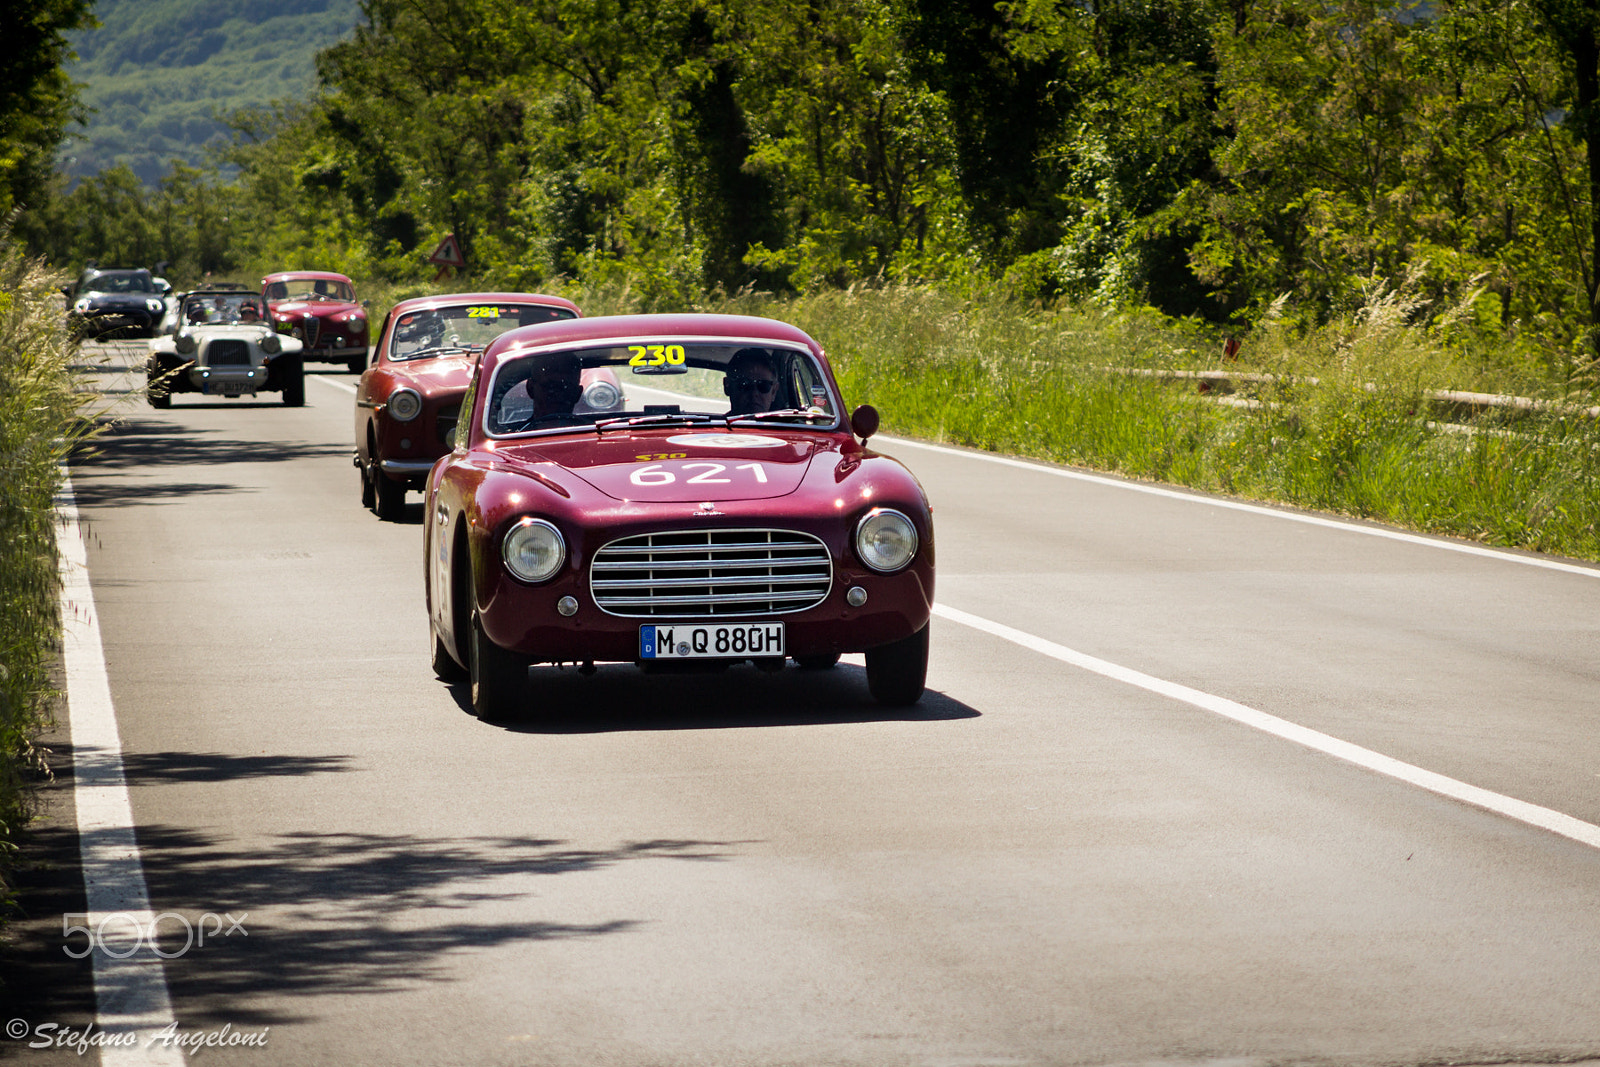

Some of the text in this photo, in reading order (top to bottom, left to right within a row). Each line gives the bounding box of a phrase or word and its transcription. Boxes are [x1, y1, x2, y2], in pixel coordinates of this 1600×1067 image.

[467, 306, 499, 318] 281
[628, 345, 686, 366] 230
[629, 463, 768, 486] 621
[645, 644, 652, 653] D
[657, 629, 674, 654] M
[715, 627, 782, 653] 880H
